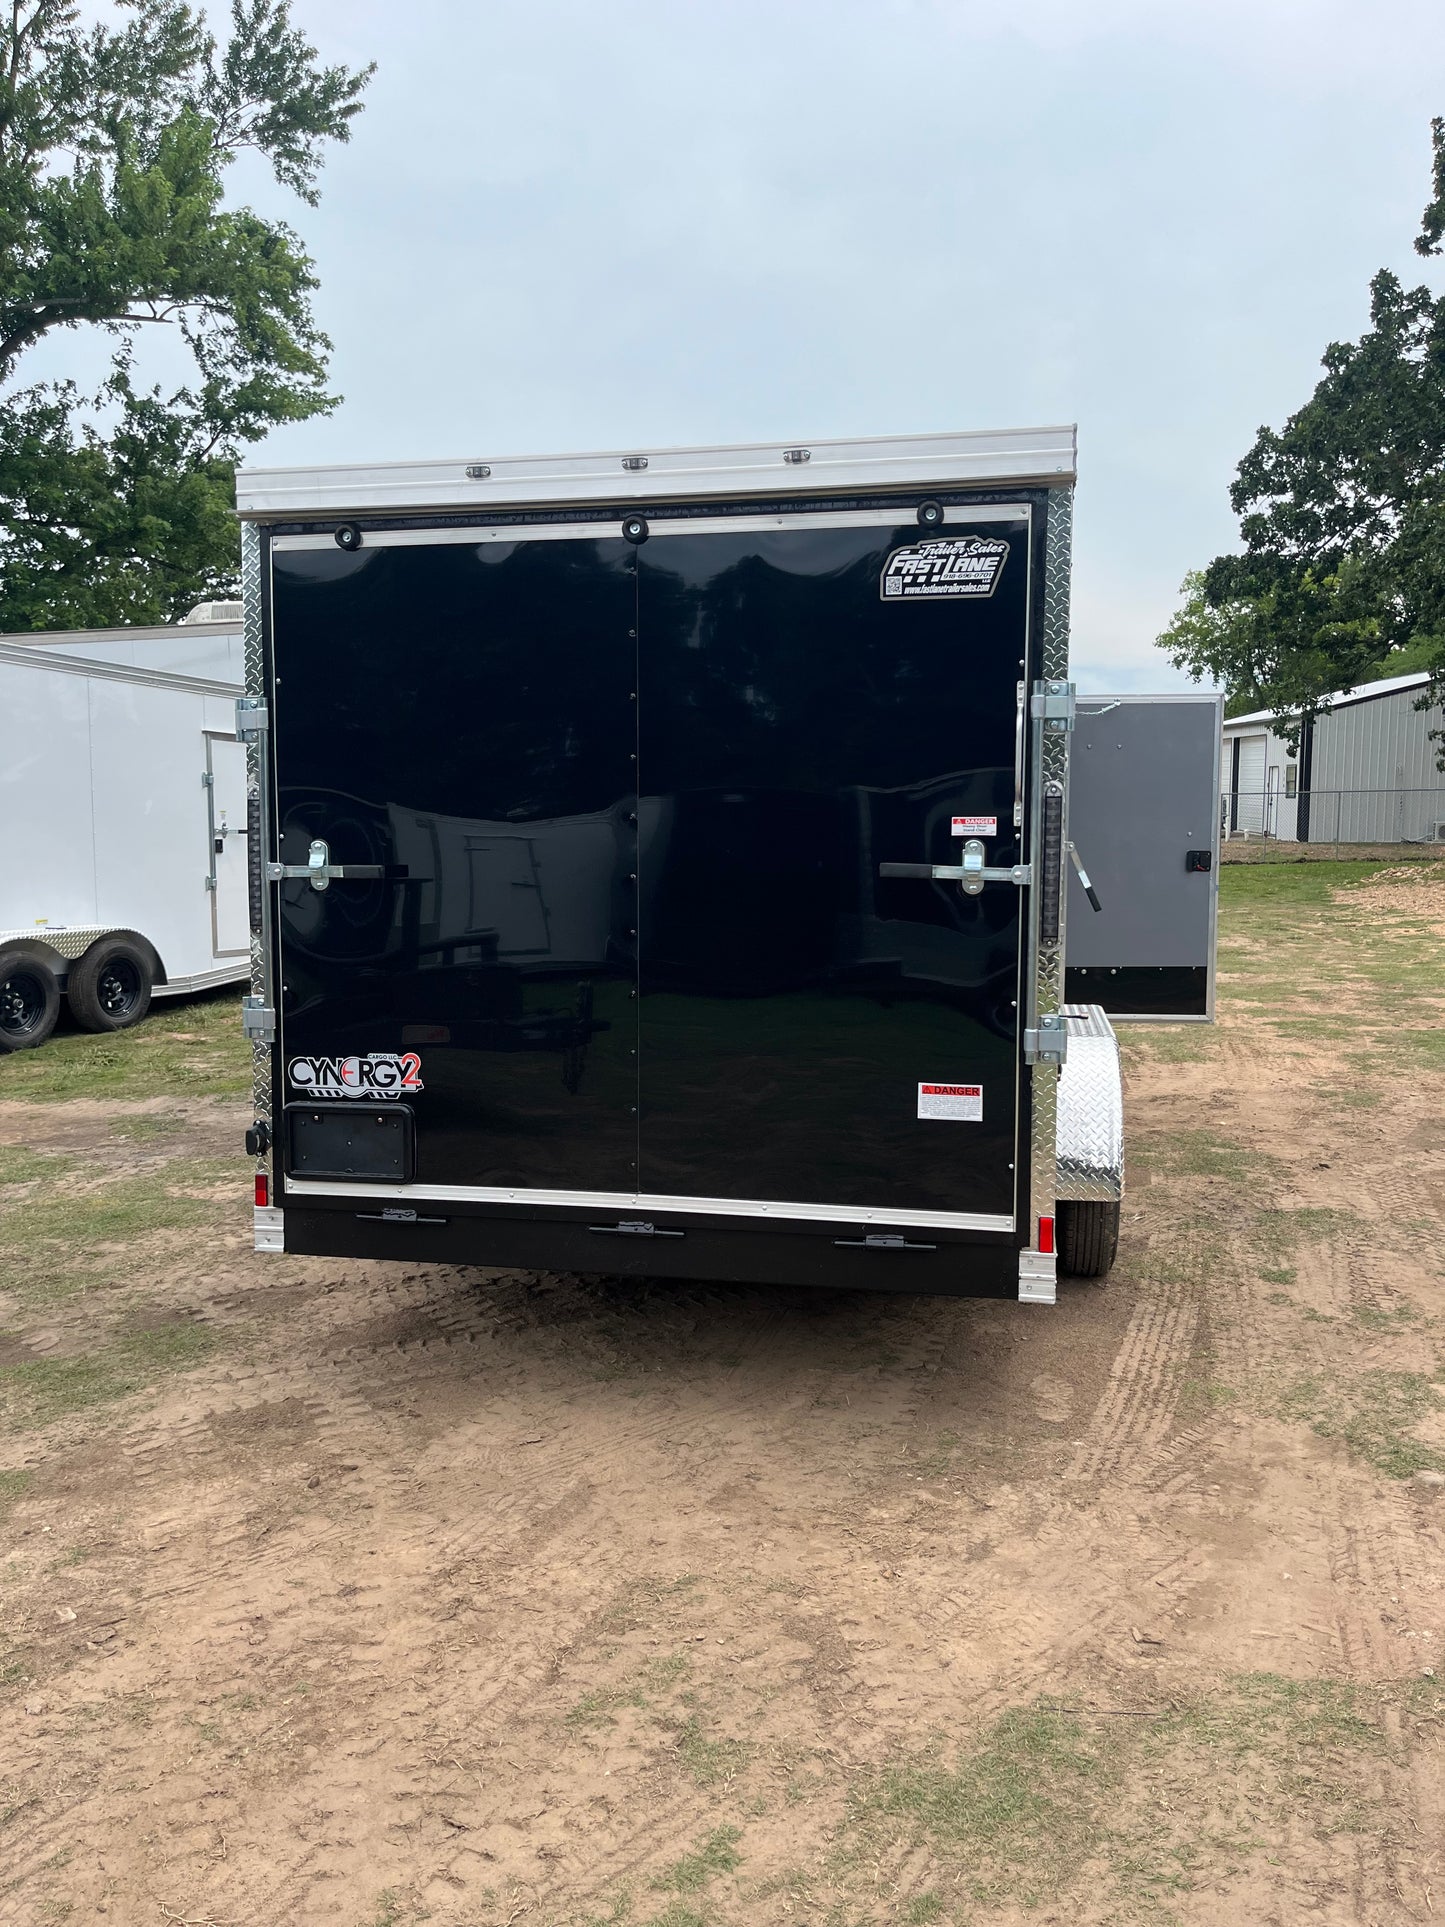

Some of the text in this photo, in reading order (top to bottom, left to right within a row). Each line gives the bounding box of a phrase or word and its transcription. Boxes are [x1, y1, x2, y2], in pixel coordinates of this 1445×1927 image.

[921, 541, 1005, 557] Trailer Sales
[943, 572, 992, 580] 918-696-0701
[904, 583, 990, 595] www.fastlanetrailersales.com
[933, 1085, 980, 1096] DANGER
